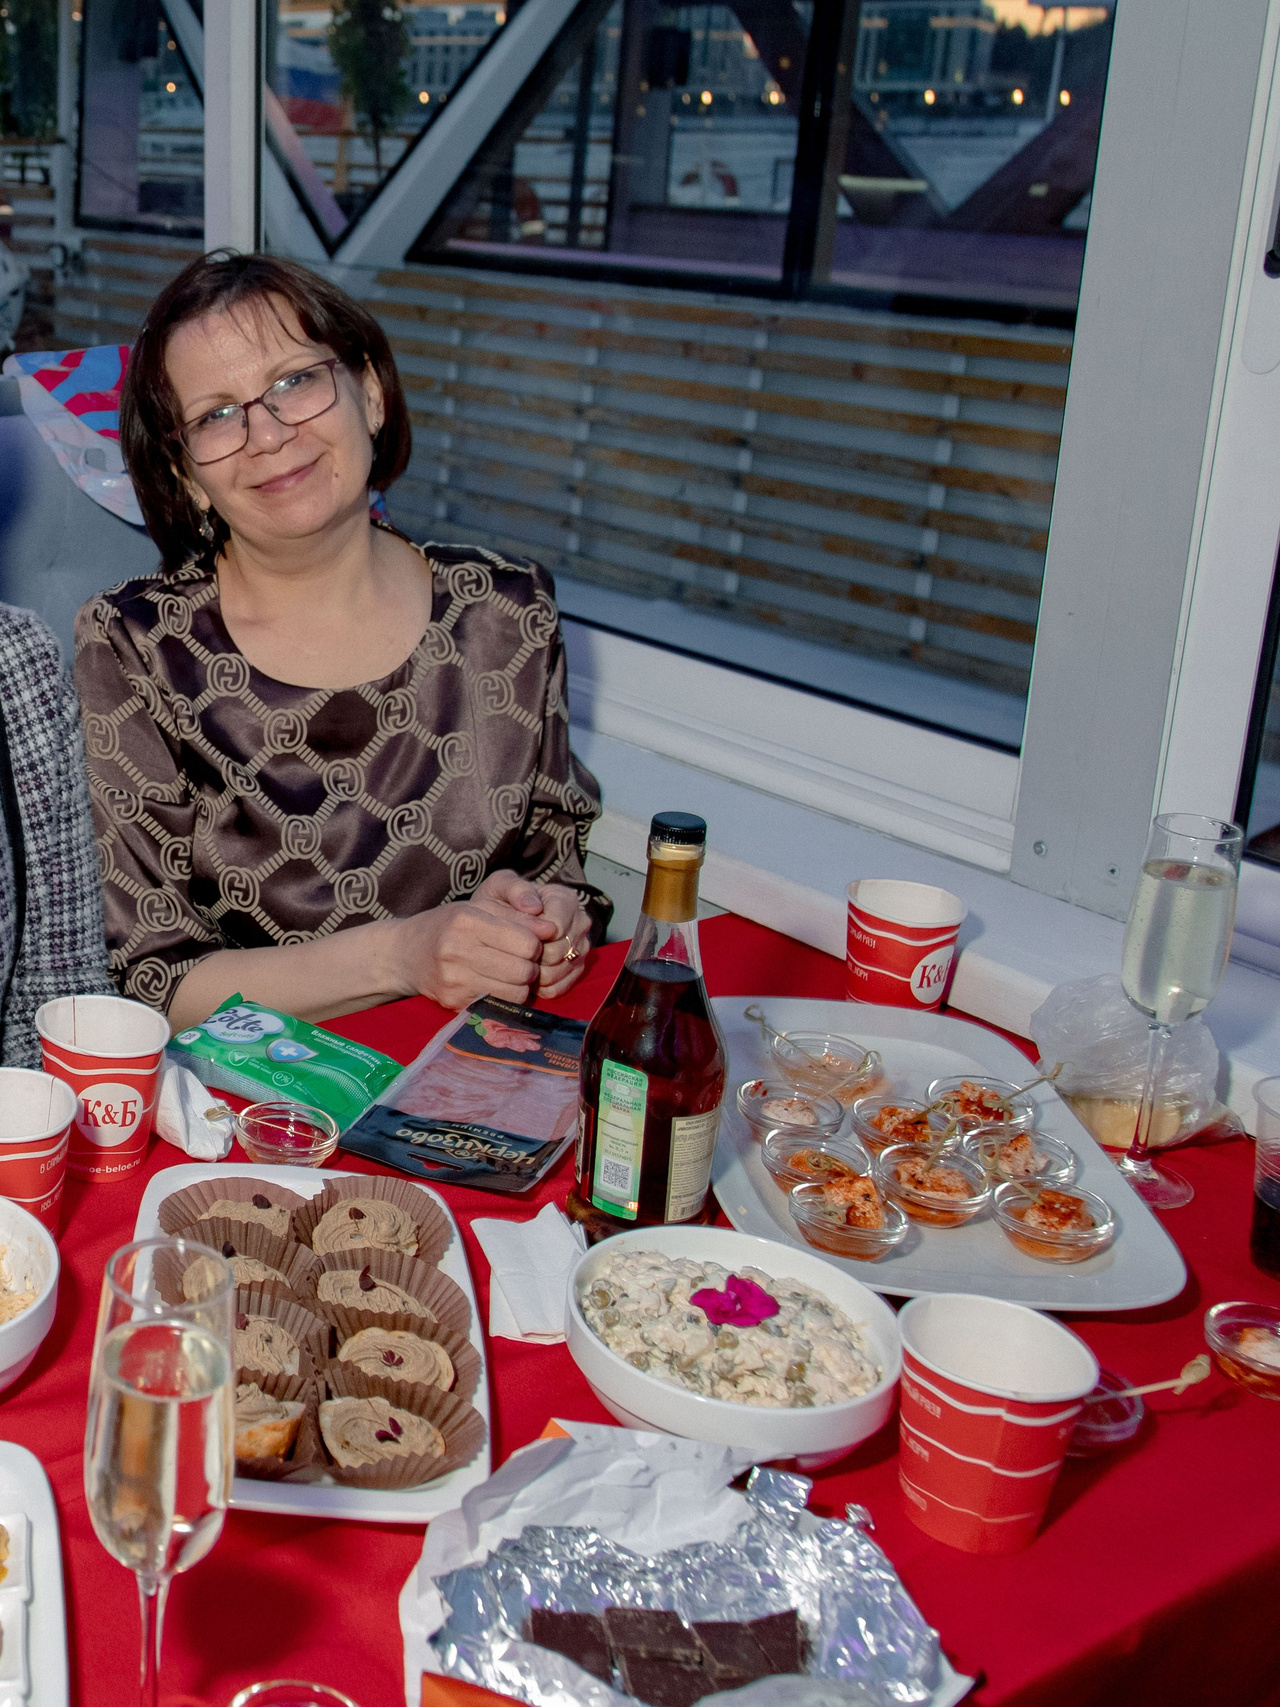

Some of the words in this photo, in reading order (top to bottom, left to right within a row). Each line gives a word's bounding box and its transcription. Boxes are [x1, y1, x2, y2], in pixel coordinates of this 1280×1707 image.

[311, 1029, 346, 1047] Влажные
[543, 1051, 580, 1066] МЕНКО
[547, 1058, 579, 1070] ЛЯМИ
[606, 1067, 644, 1083] РОССИЙСКАЯ
[606, 1072, 643, 1087] ФЕДЕРАЦИЯ
[603, 1091, 642, 1107] ФЕДЕРАЛЬНАЯ
[81, 1097, 138, 1129] К&Б
[451, 1123, 504, 1140] PREMIUM
[395, 1127, 537, 1164] Черкизово
